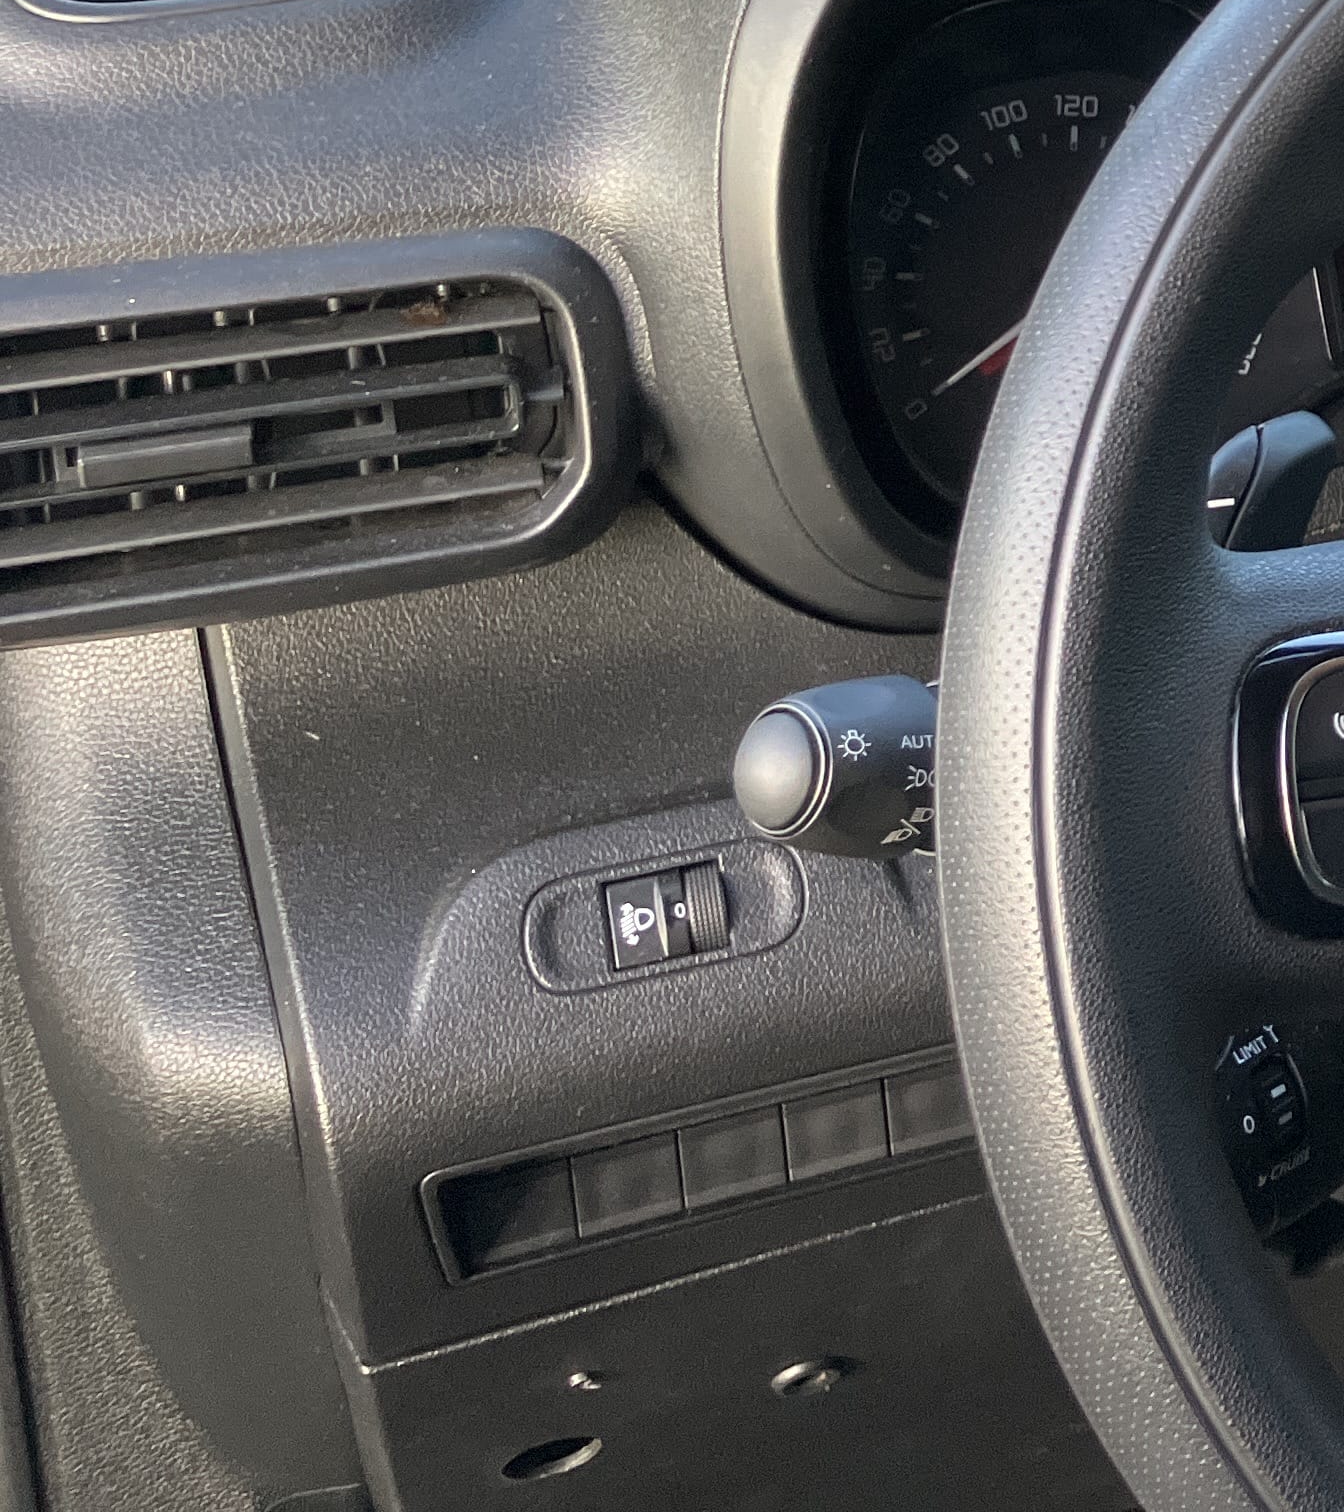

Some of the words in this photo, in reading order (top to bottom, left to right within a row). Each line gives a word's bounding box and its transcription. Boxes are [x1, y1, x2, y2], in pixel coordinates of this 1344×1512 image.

[979, 99, 1029, 132] 100
[1053, 94, 1099, 118] 120
[922, 133, 960, 168] 80
[904, 398, 929, 422] 0
[900, 733, 936, 749] AUT
[1231, 1034, 1269, 1065] LIMIT
